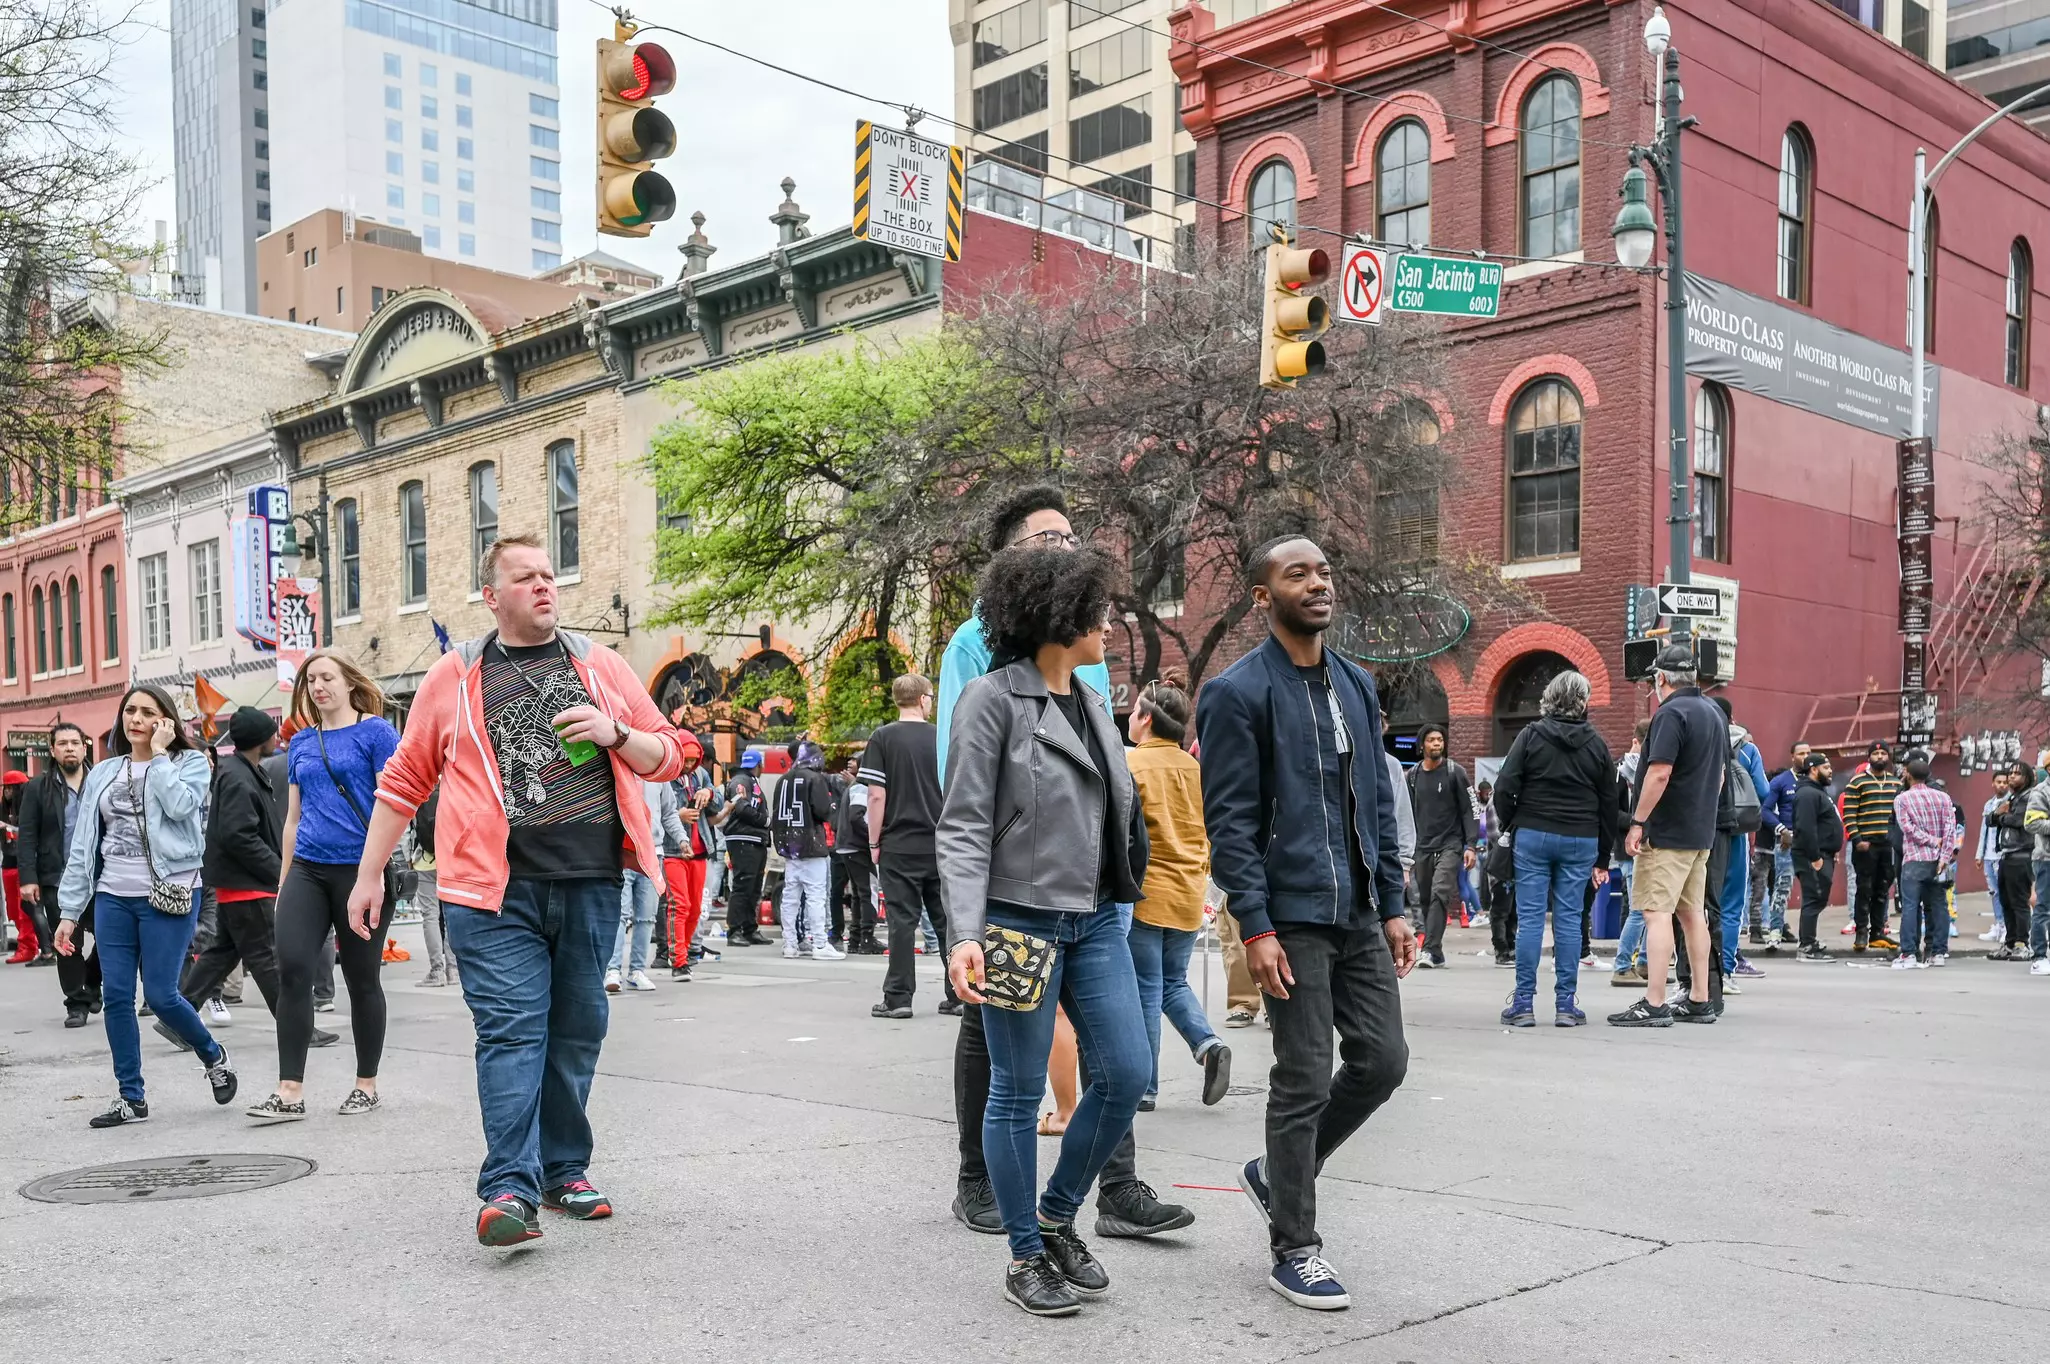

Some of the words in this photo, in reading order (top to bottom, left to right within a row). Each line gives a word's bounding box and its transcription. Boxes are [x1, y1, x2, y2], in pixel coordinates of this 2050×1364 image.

[873, 129, 905, 150] DON'T
[909, 140, 947, 162] BLOCK
[883, 209, 905, 228] THE
[910, 216, 933, 235] BOX
[871, 226, 882, 239] UP
[887, 231, 897, 243] TO
[900, 235, 922, 250] $500
[924, 240, 943, 255] FINE
[1397, 259, 1423, 289] San
[1427, 262, 1476, 293] Jacinto
[1479, 267, 1500, 286] BLVD
[1404, 291, 1424, 308] 500
[1469, 296, 1487, 312] 600
[399, 310, 433, 341] WEBB
[435, 311, 444, 328] &
[1685, 294, 1740, 336] WORLD
[1741, 316, 1784, 352] CLASS
[1688, 326, 1739, 357] PROPERTY
[1741, 345, 1784, 373] COMPANY
[1793, 339, 1838, 372] ANOTHER
[1839, 355, 1872, 383] WORLD
[1873, 367, 1898, 392] CLASS
[252, 527, 260, 551] BAR
[253, 563, 263, 621] KITCHEN
[279, 597, 306, 618] SX
[1676, 594, 1694, 607] ONE
[1696, 595, 1715, 608] WAY
[279, 616, 312, 635] SW
[778, 778, 805, 827] 45
